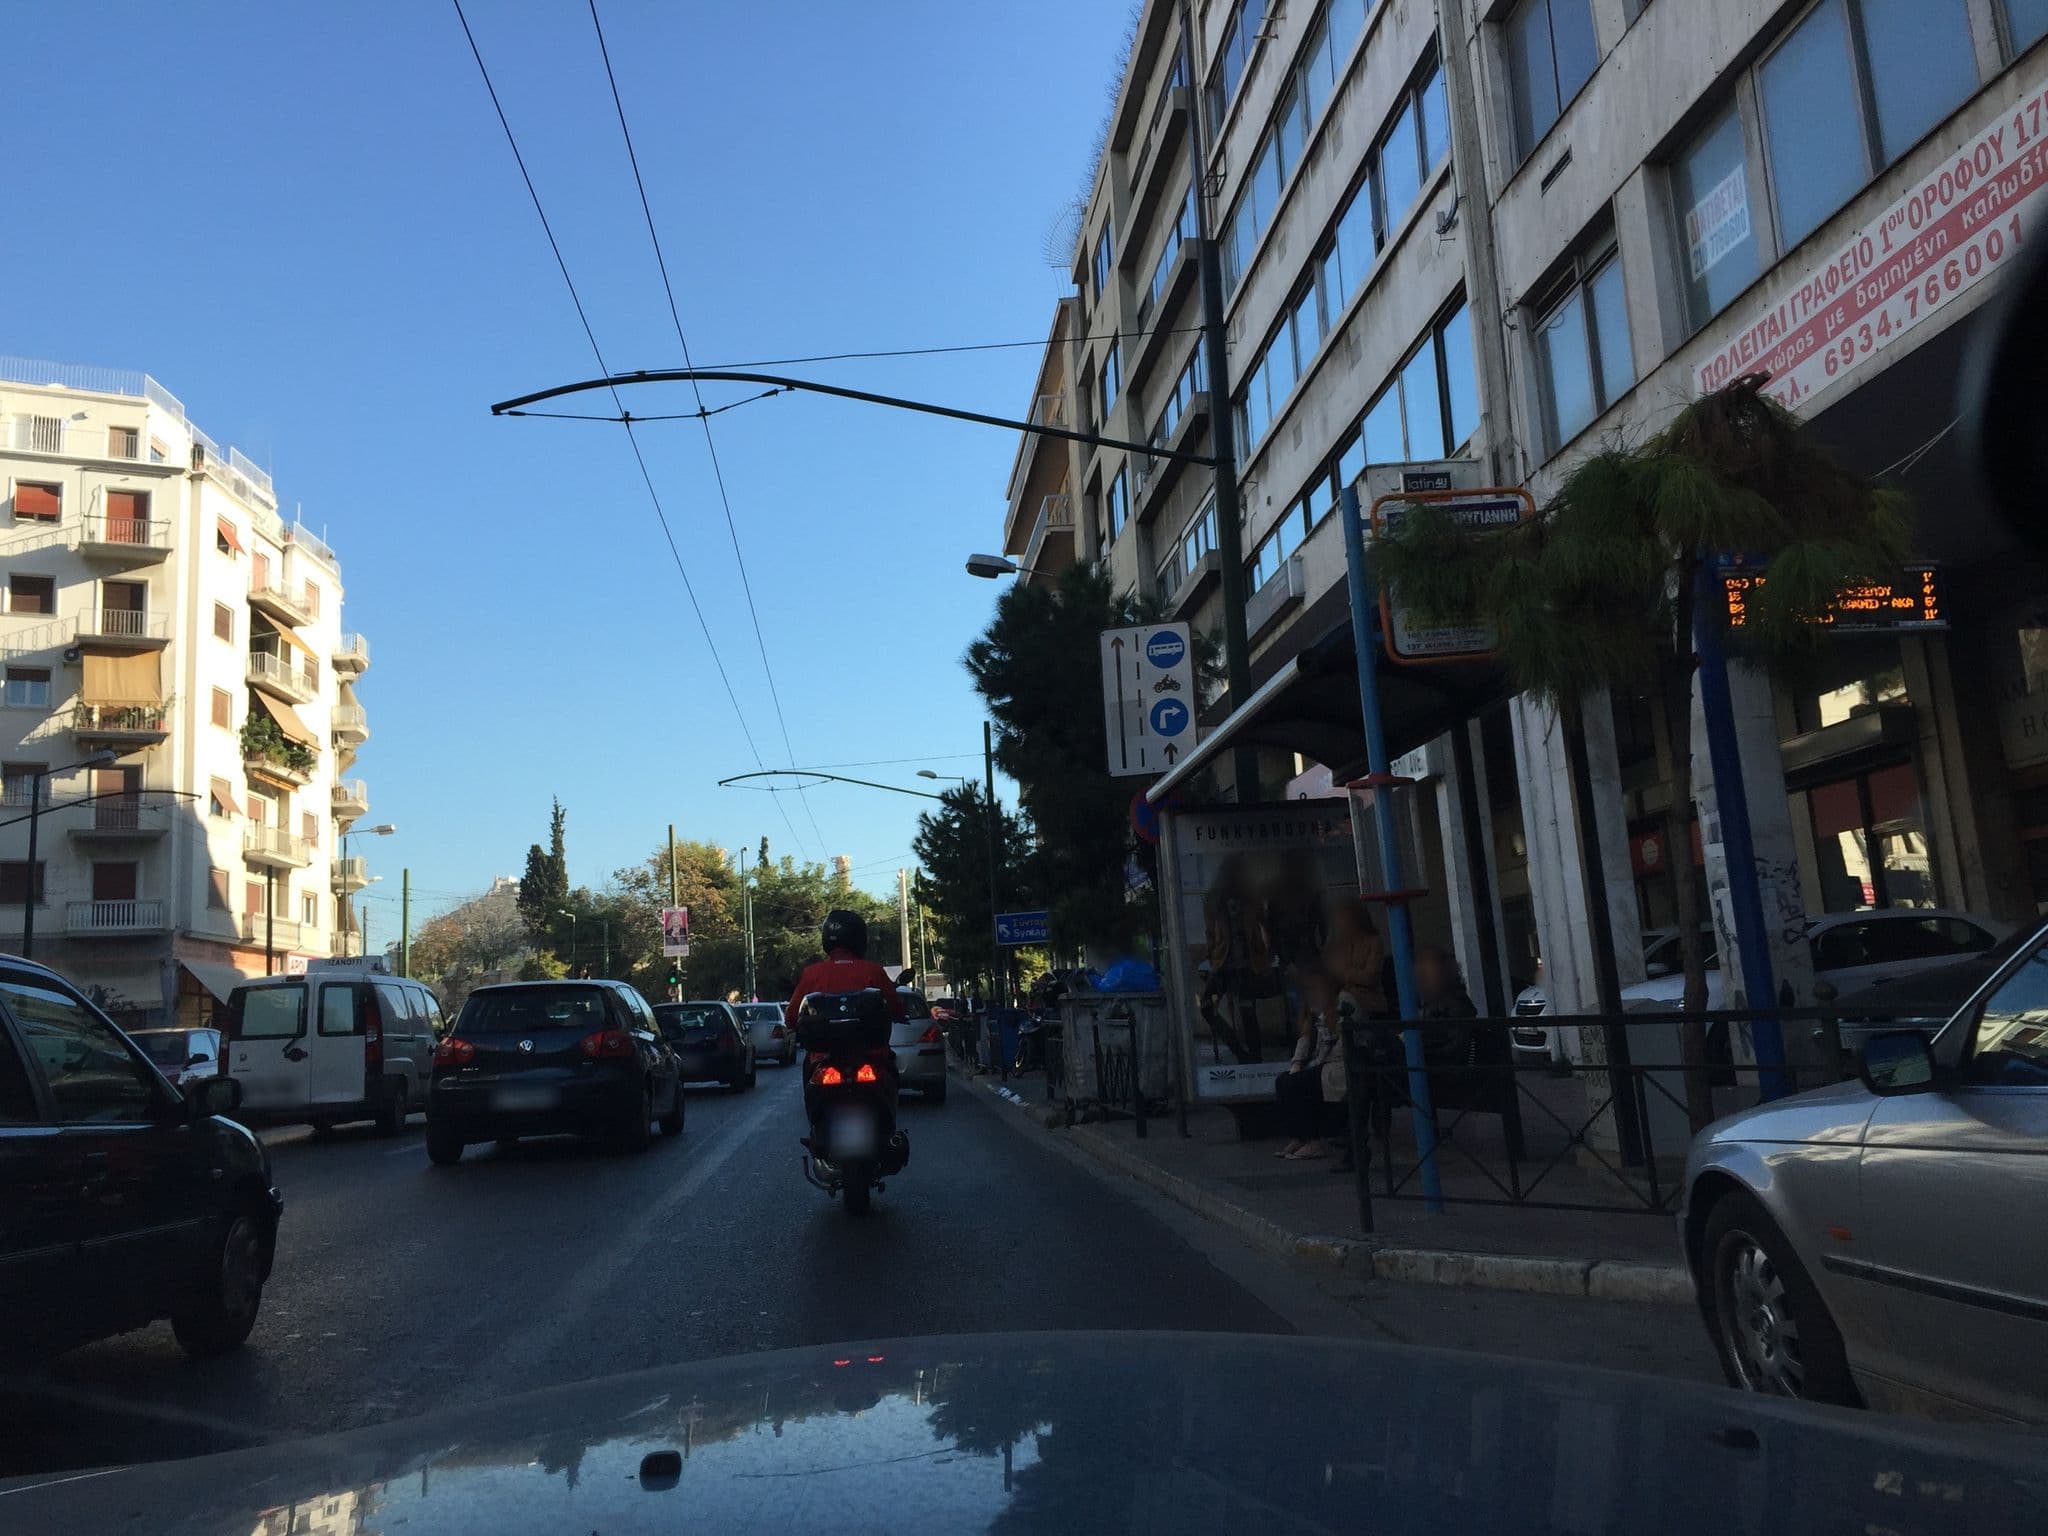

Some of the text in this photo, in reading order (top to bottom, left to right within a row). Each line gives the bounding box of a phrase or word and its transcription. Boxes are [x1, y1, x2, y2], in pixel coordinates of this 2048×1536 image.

[1700, 317, 1788, 393] ΠΩΛΕΙΤΑΙ
[1790, 236, 1874, 324] ΓΡΑΦΕΙΟ
[1908, 127, 2006, 230] ΟΡΟΦΟΥ
[1824, 309, 1845, 339] με
[1961, 145, 2048, 230] καλωδί
[1014, 928, 1048, 939] Syntag
